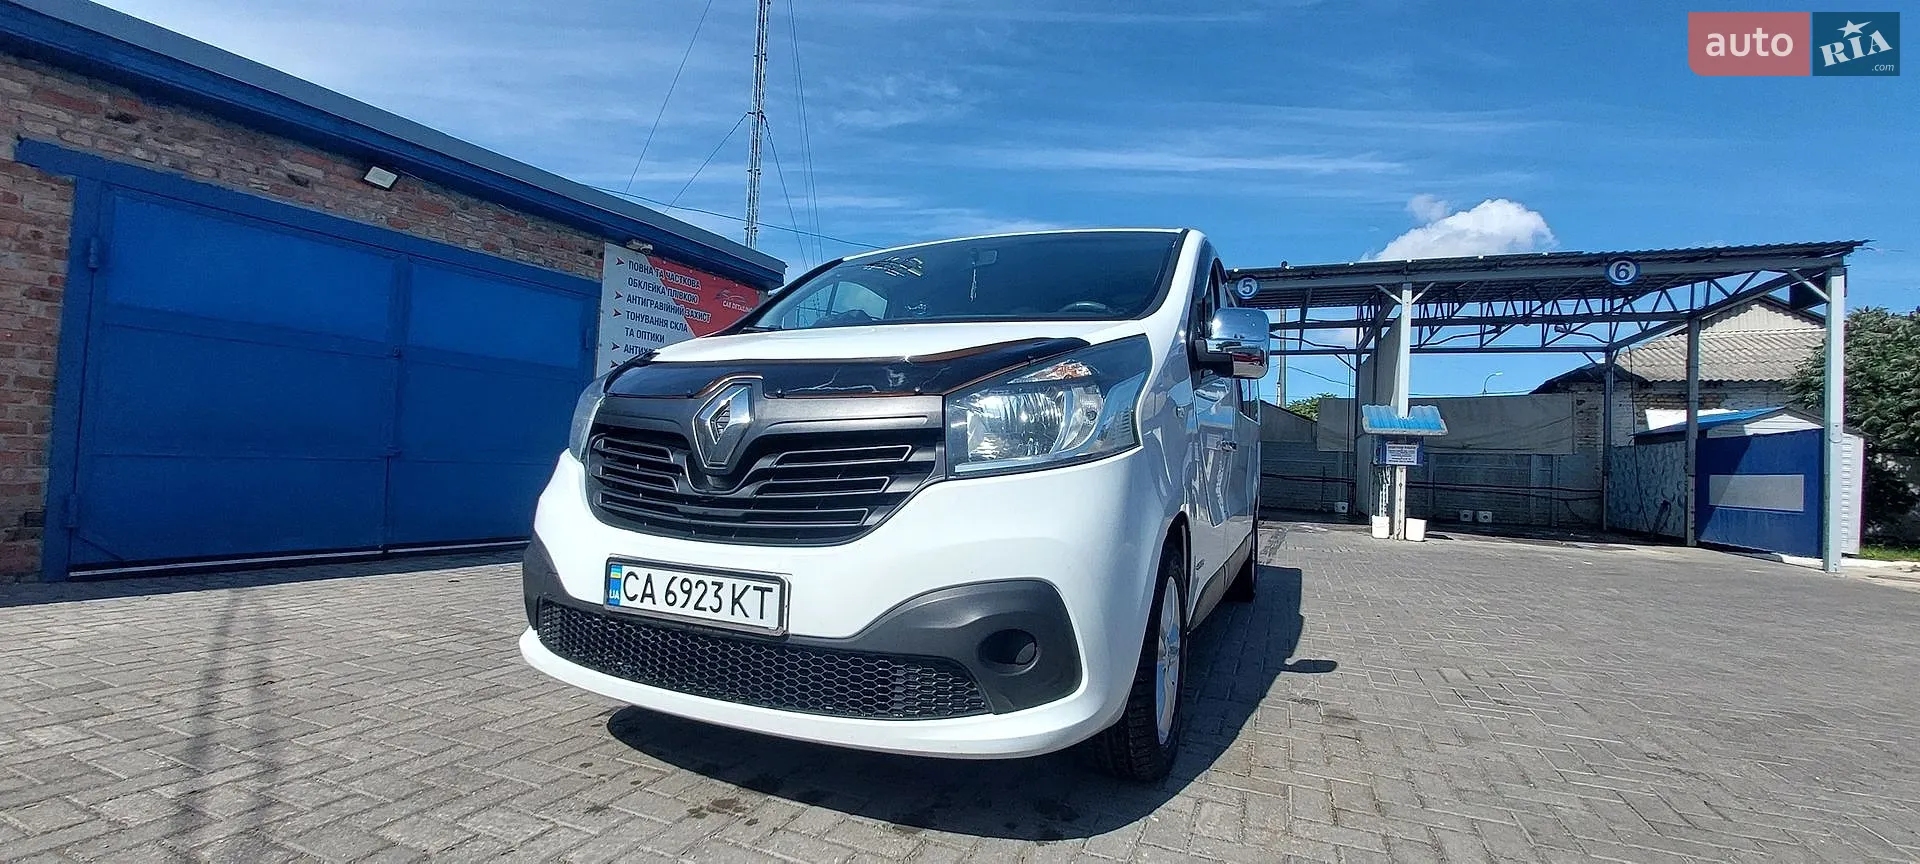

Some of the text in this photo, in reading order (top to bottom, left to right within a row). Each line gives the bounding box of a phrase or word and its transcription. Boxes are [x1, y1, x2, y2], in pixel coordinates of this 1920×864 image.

[628, 260, 702, 290] ПОВНА ТА ЧАСТКОВА
[1615, 262, 1630, 280] 6
[627, 277, 699, 304] ОБКЛЕЙКА ПЛІВКОЮ
[1243, 279, 1254, 295] 5
[626, 293, 711, 324] АНТИГРАВІЙНИЙ ЗАХИСТ
[625, 310, 688, 332] ТОНУВАННЯ СКЛА
[625, 326, 665, 344] ТА ОПТИКИ
[609, 589, 620, 600] UA
[623, 571, 773, 620] CA 6923 KT
